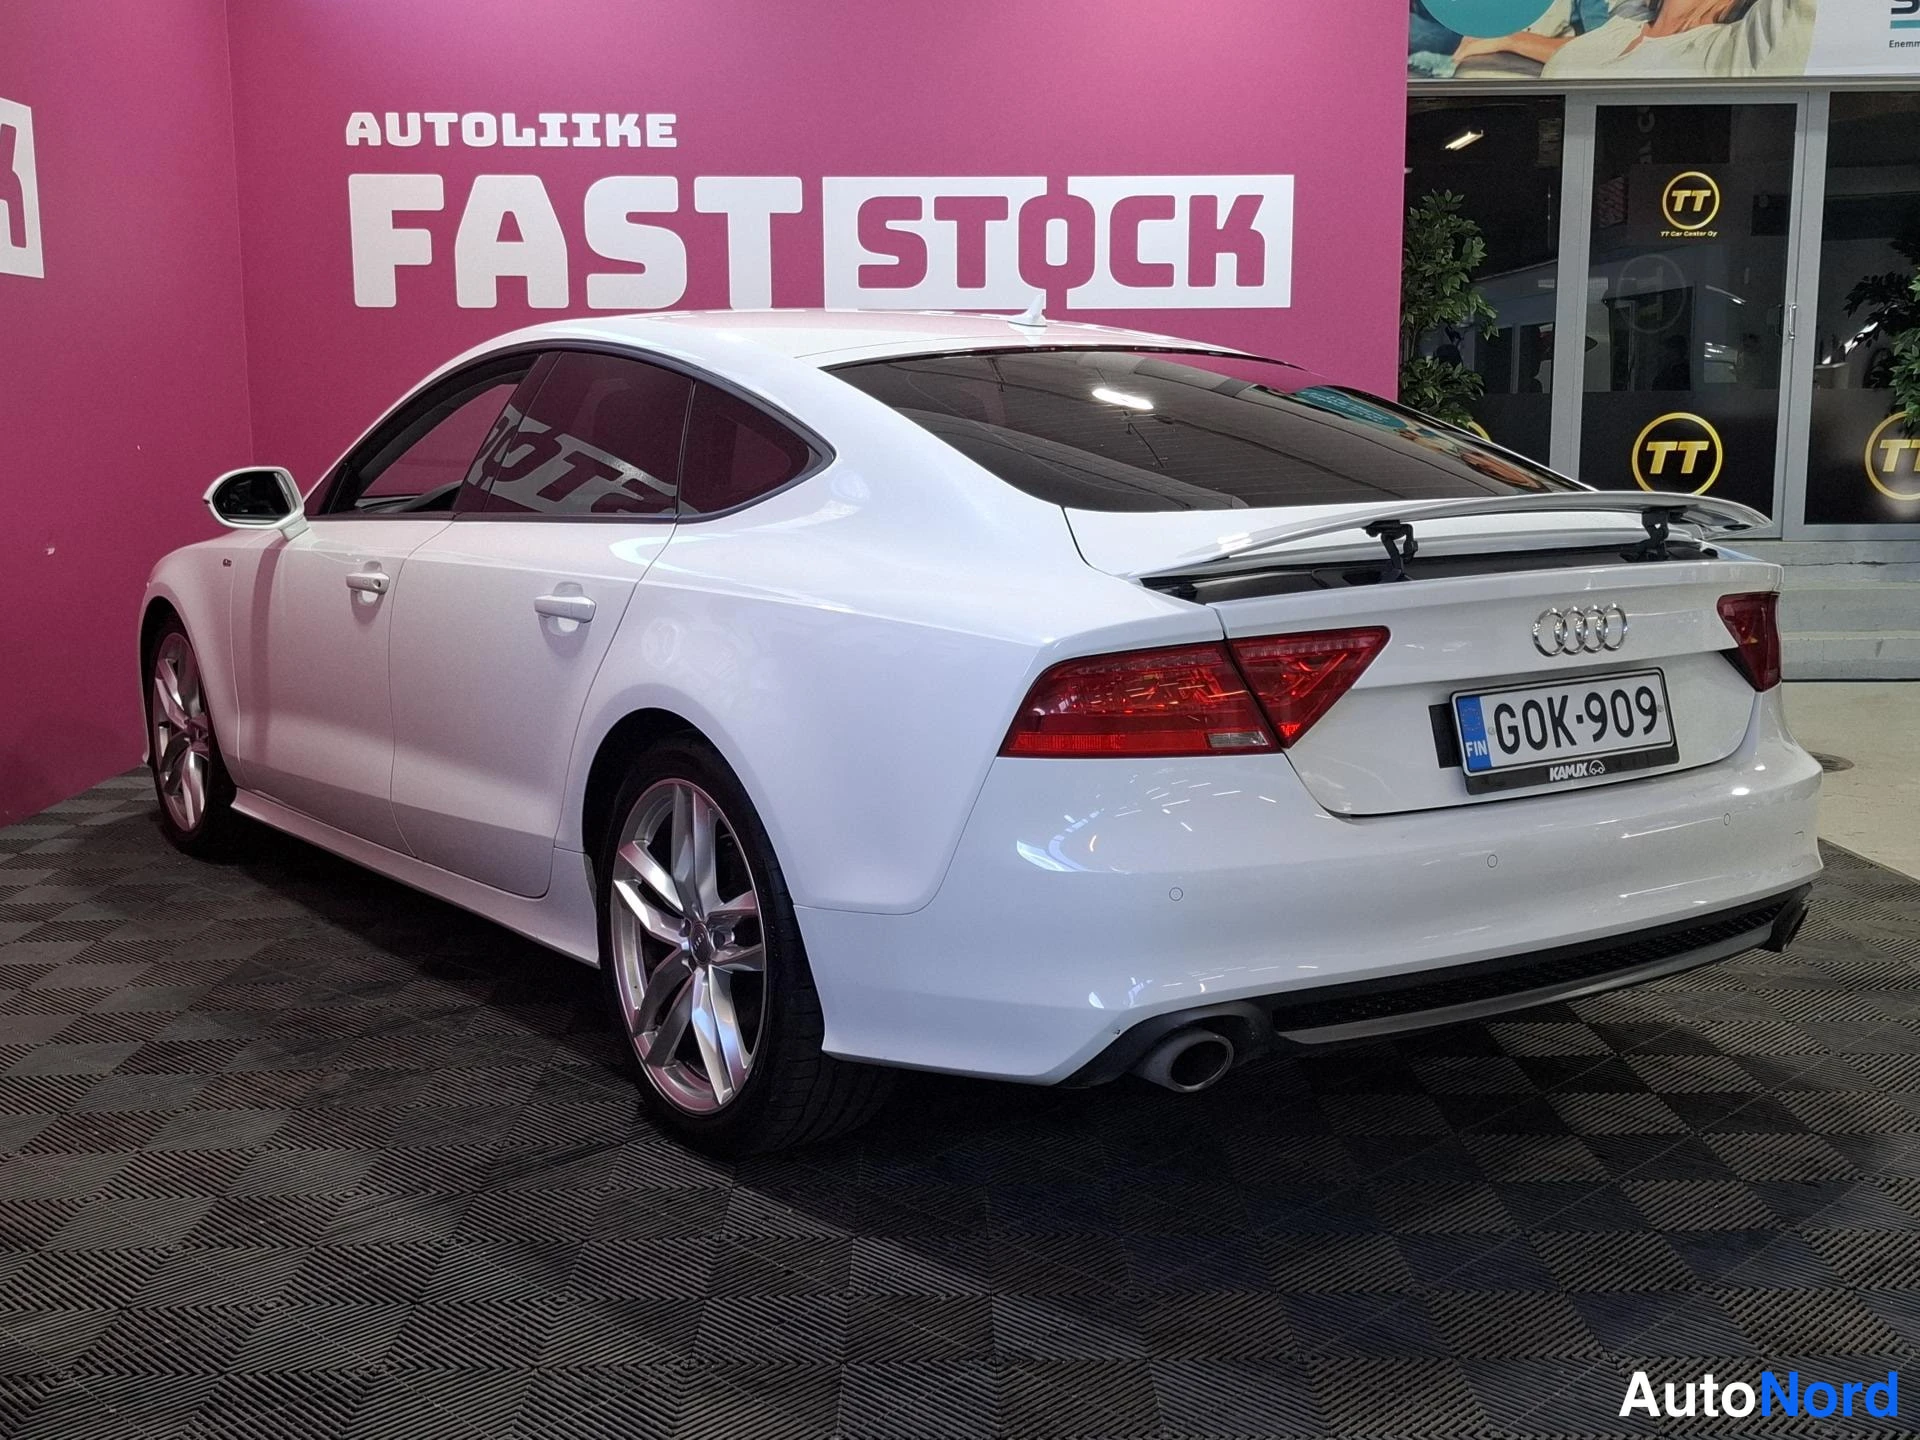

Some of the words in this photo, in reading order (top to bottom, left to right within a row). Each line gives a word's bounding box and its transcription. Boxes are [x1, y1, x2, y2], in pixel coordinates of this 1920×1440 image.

[346, 112, 677, 147] AUTOLIIKE
[1671, 189, 1711, 212] TT
[348, 173, 802, 310] FAST
[857, 194, 1266, 290] STOCK
[1646, 441, 1709, 474] TT
[1466, 740, 1489, 758] FIN
[1494, 686, 1658, 755] GOK-909
[1549, 762, 1588, 781] KAMUX
